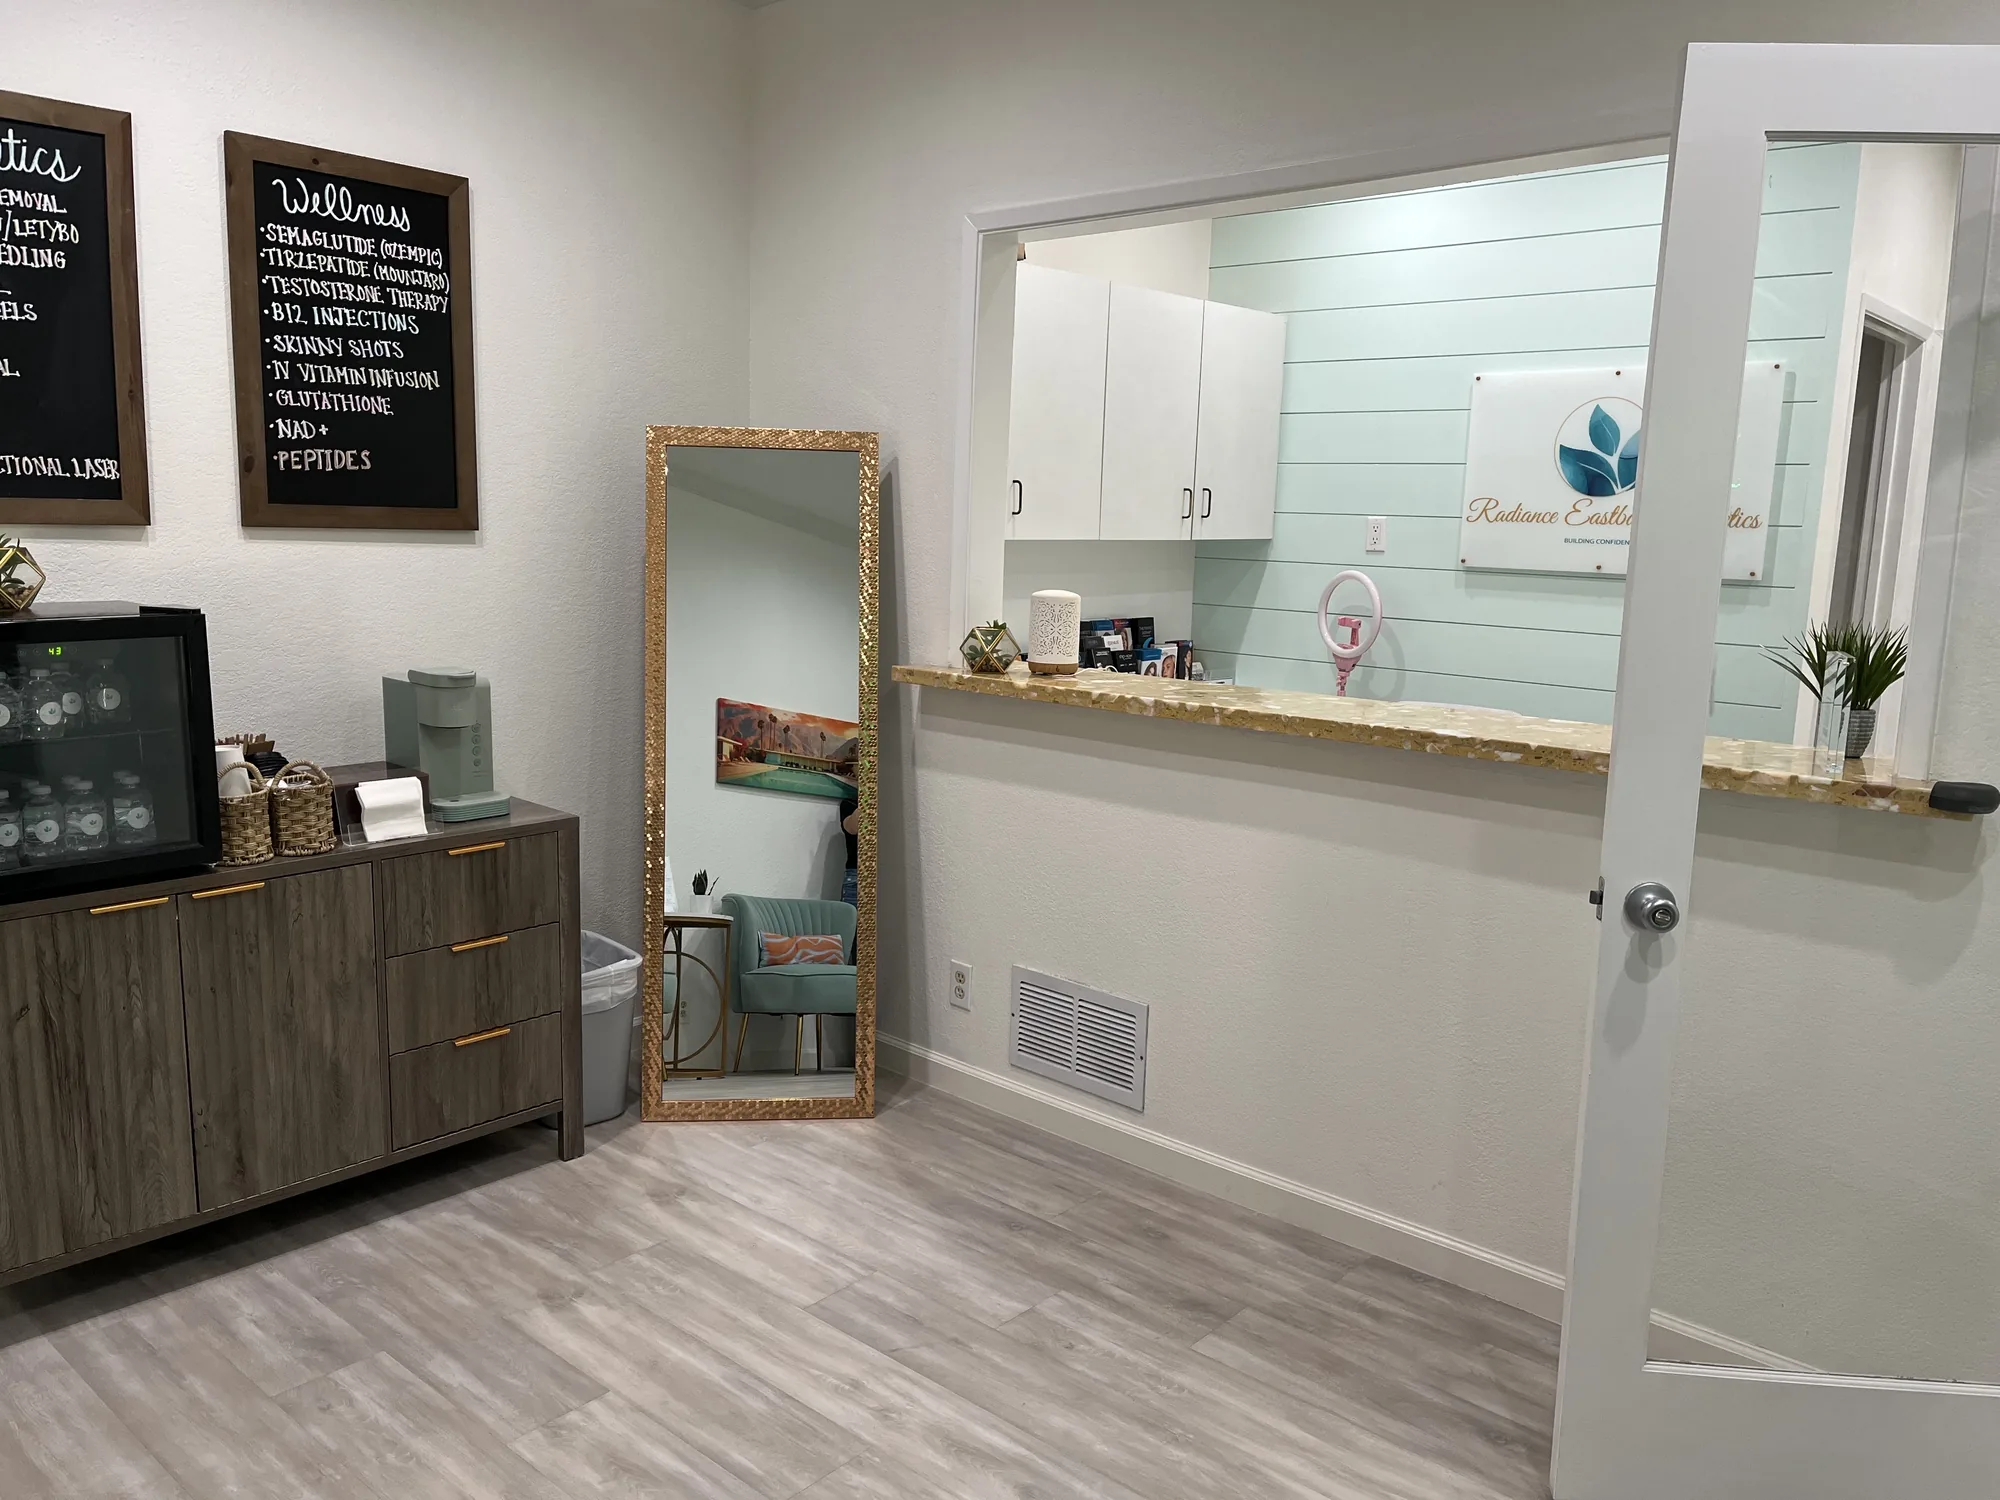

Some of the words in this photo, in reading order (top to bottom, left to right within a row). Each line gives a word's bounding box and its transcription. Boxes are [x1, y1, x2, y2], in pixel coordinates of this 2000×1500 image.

[0, 128, 81, 182] tics
[272, 178, 410, 232] Wellness
[0, 210, 80, 244] /LETYBO
[266, 223, 377, 258] SEMAGLUTIDE
[380, 238, 443, 270] (OZEMPIC)
[263, 248, 371, 278] TIRZEPATIDE
[373, 261, 450, 295] (MOUNJARO)
[265, 275, 384, 304] TESTOSTERONE
[387, 287, 449, 313] THERAPY
[0, 300, 38, 321] ELS
[271, 302, 308, 325] B12
[312, 306, 420, 334] INJECTIONS
[273, 334, 343, 357] SKINNY
[348, 339, 404, 359] SHOTS
[272, 360, 290, 380] IV
[297, 362, 367, 386] VITAMIN
[368, 368, 441, 391] INFUSION
[276, 389, 394, 415] GLUTATHIONE
[71, 457, 120, 480] LASER
[277, 449, 372, 472] PEPTIDES
[1466, 497, 1559, 524] Radiance
[1728, 507, 1763, 529] tics
[1564, 537, 1595, 545] BUILDING
[1596, 538, 1631, 546] CONFIDEN
[48, 646, 62, 656] 43
